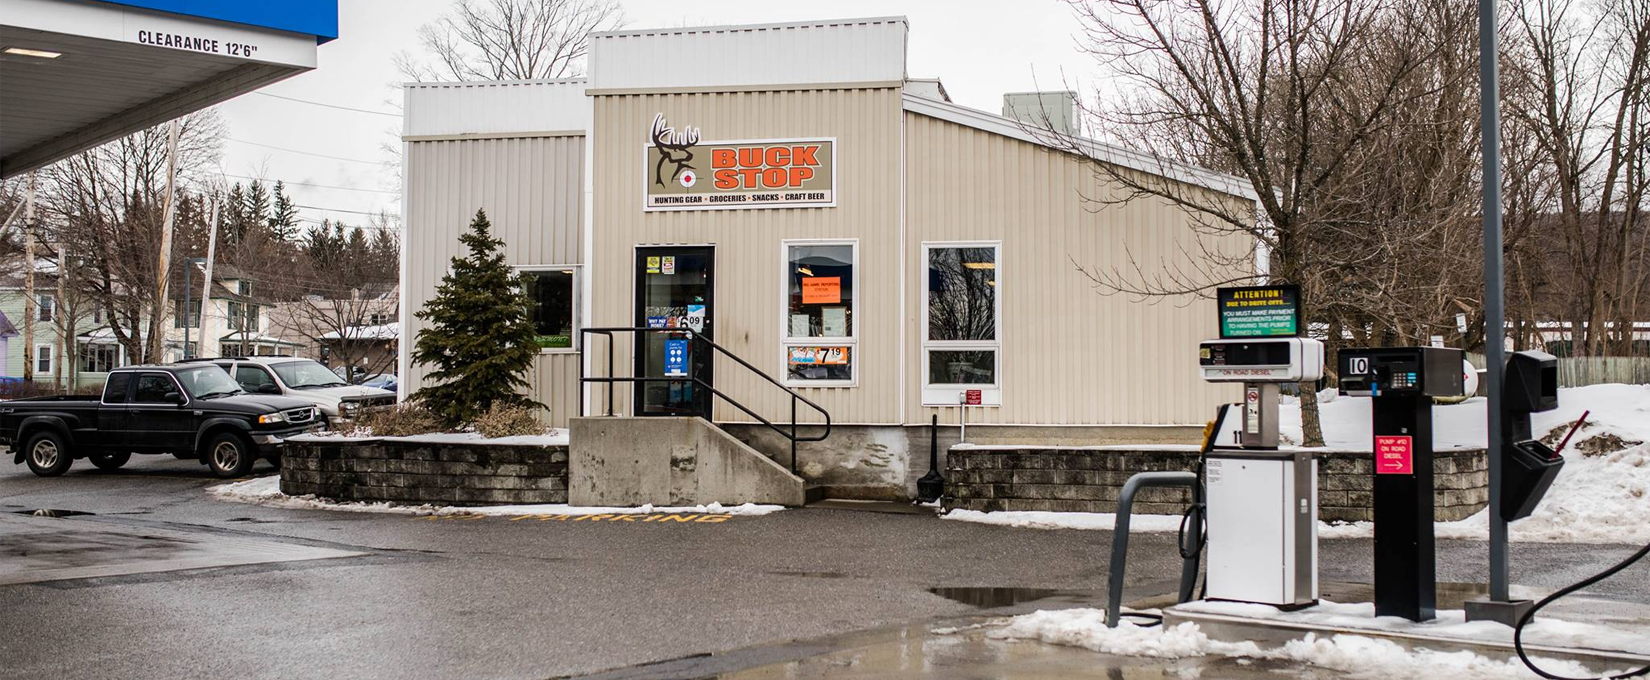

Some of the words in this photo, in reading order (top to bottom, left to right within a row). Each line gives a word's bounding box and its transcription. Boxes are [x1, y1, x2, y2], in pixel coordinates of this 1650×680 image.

[138, 30, 219, 53] CLEARANCE
[225, 42, 258, 57] 12'6"
[711, 145, 820, 169] BUCK
[714, 167, 814, 189] STOP
[654, 196, 684, 204] HUNTING
[685, 196, 703, 204] GEAR
[709, 195, 747, 203] GROCERIES
[752, 193, 779, 202] SNACKS
[785, 193, 807, 201] CRAFT
[807, 192, 825, 200] BEER
[1233, 289, 1284, 299] ATTENTION!
[1352, 358, 1368, 373] 10
[1233, 430, 1243, 444] 11
